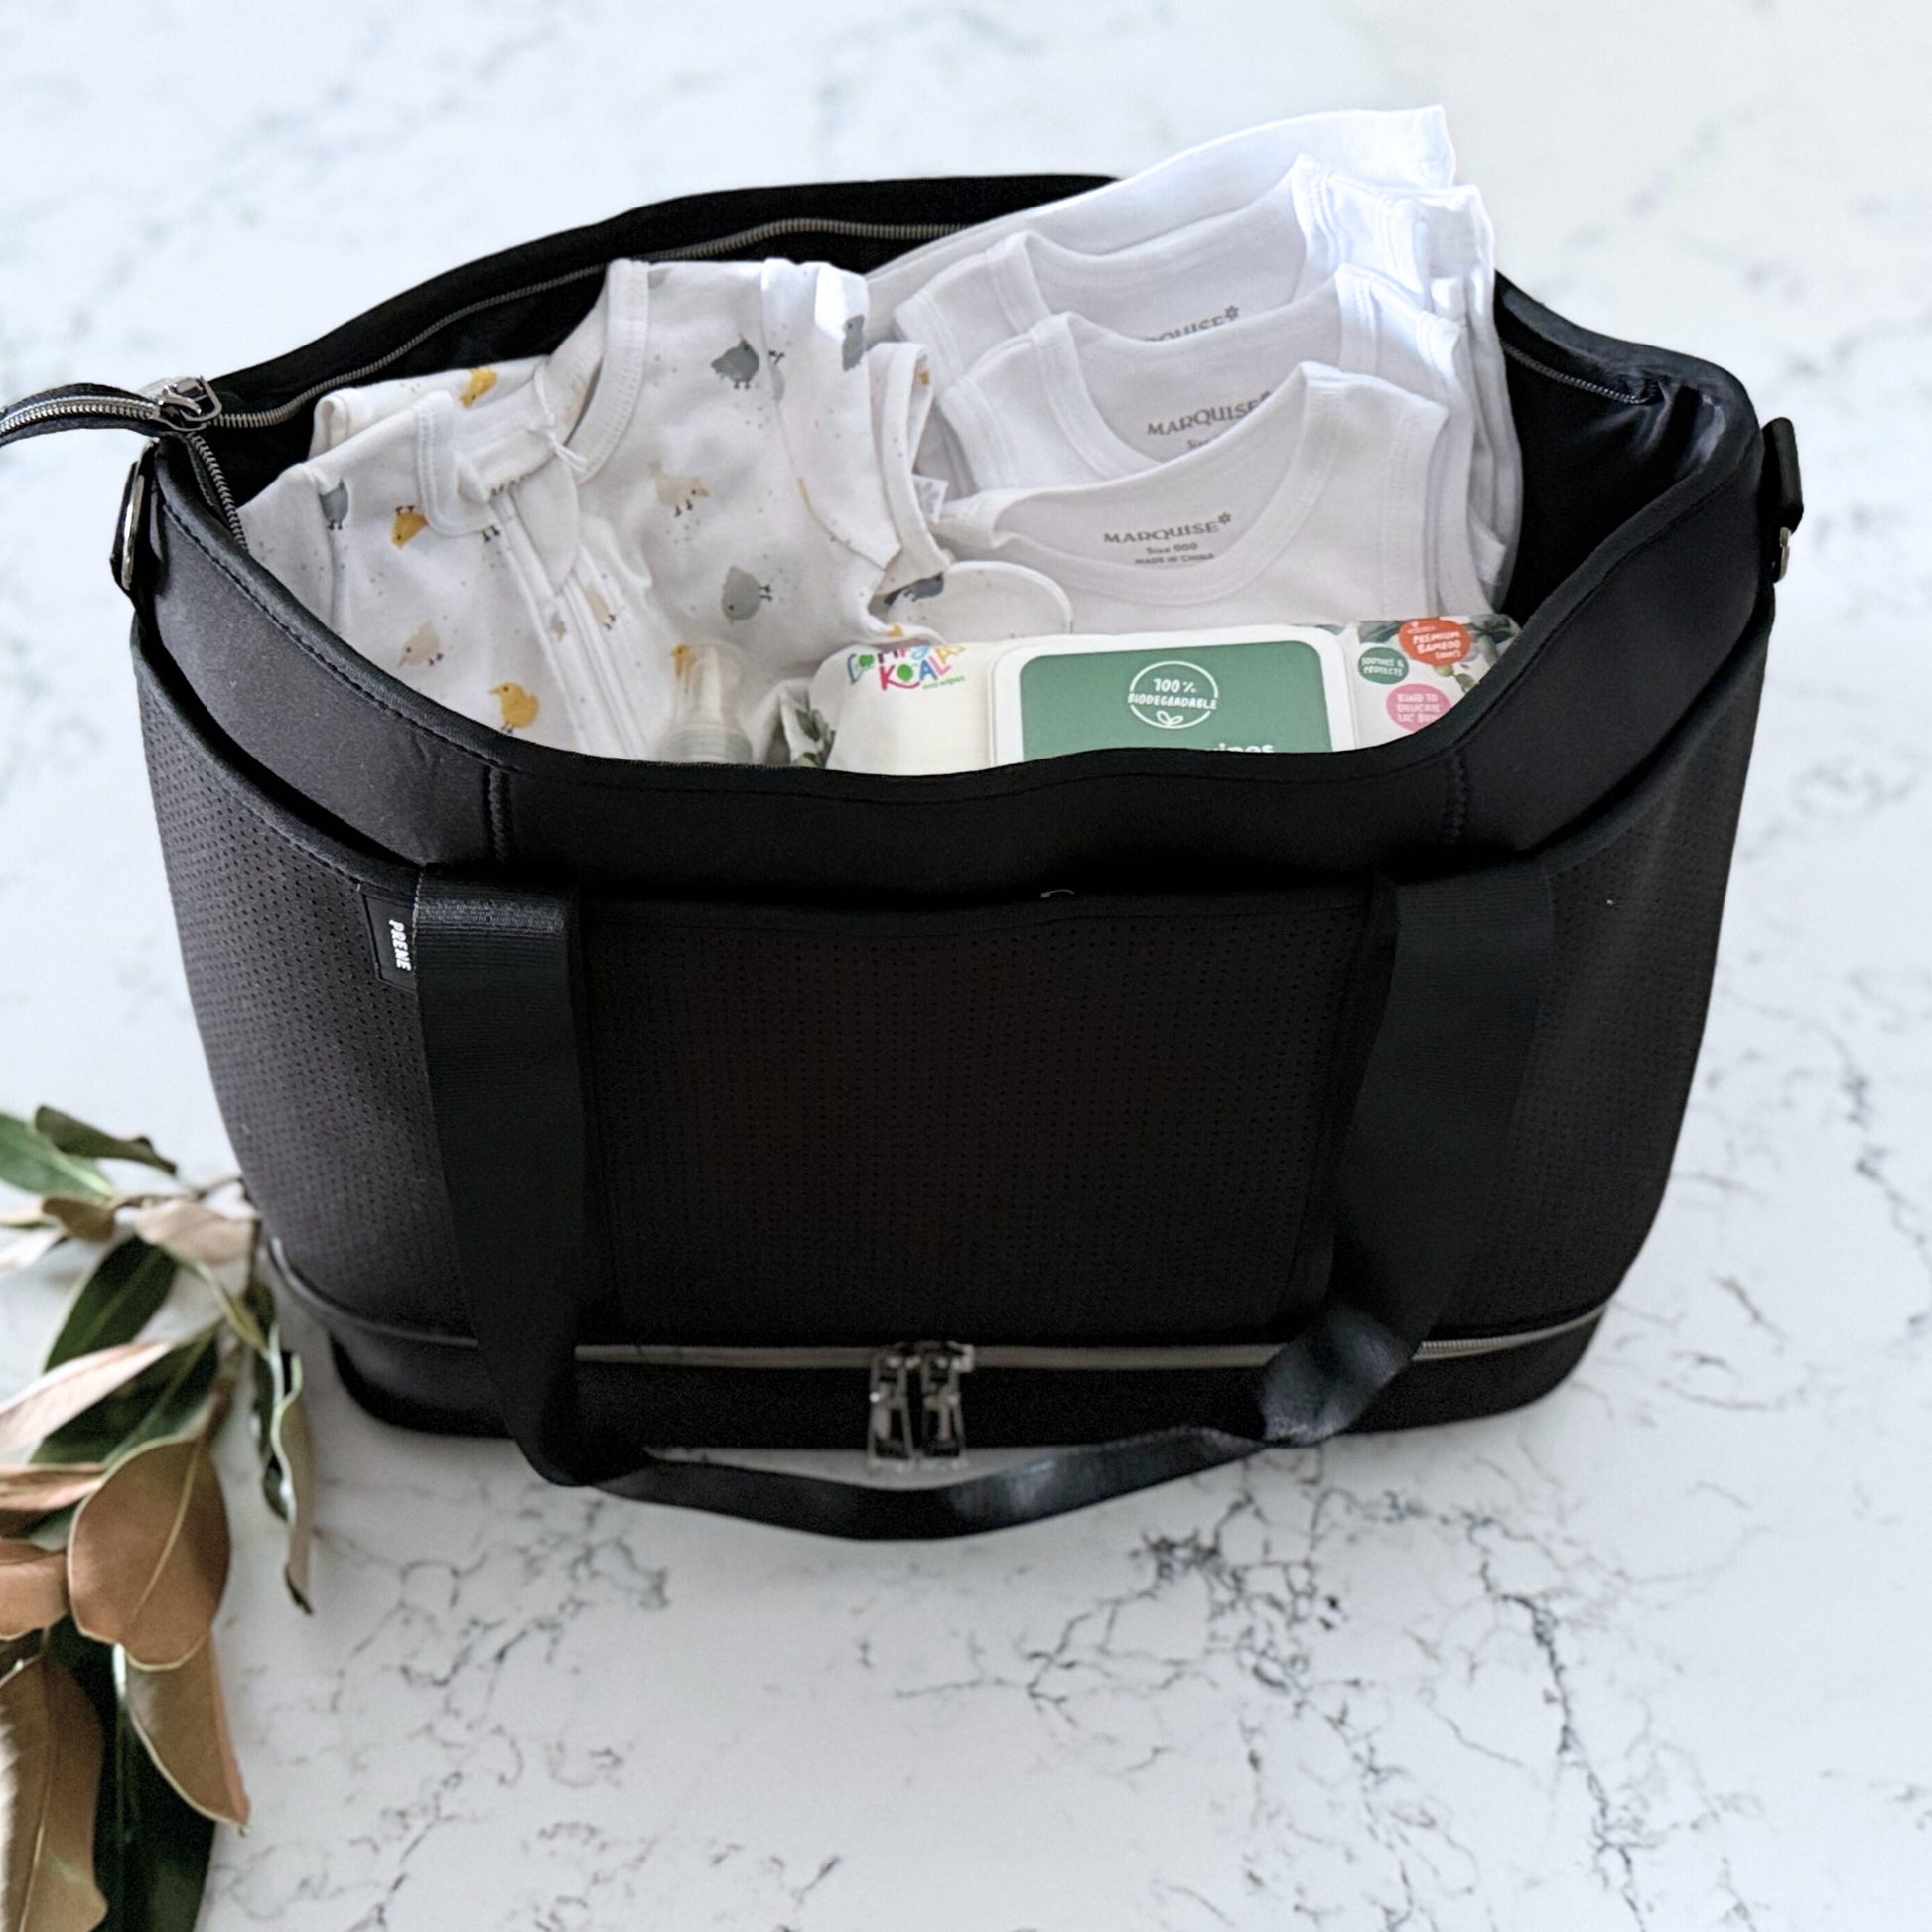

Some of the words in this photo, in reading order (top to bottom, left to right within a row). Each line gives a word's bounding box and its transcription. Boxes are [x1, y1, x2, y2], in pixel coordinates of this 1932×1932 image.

[1104, 521, 1219, 543] MARQUISE
[879, 645, 966, 691] KOALA
[1153, 678, 1197, 693] 100%
[1128, 692, 1218, 710] BIODEGRADABLE
[388, 919, 412, 971] PRENE
